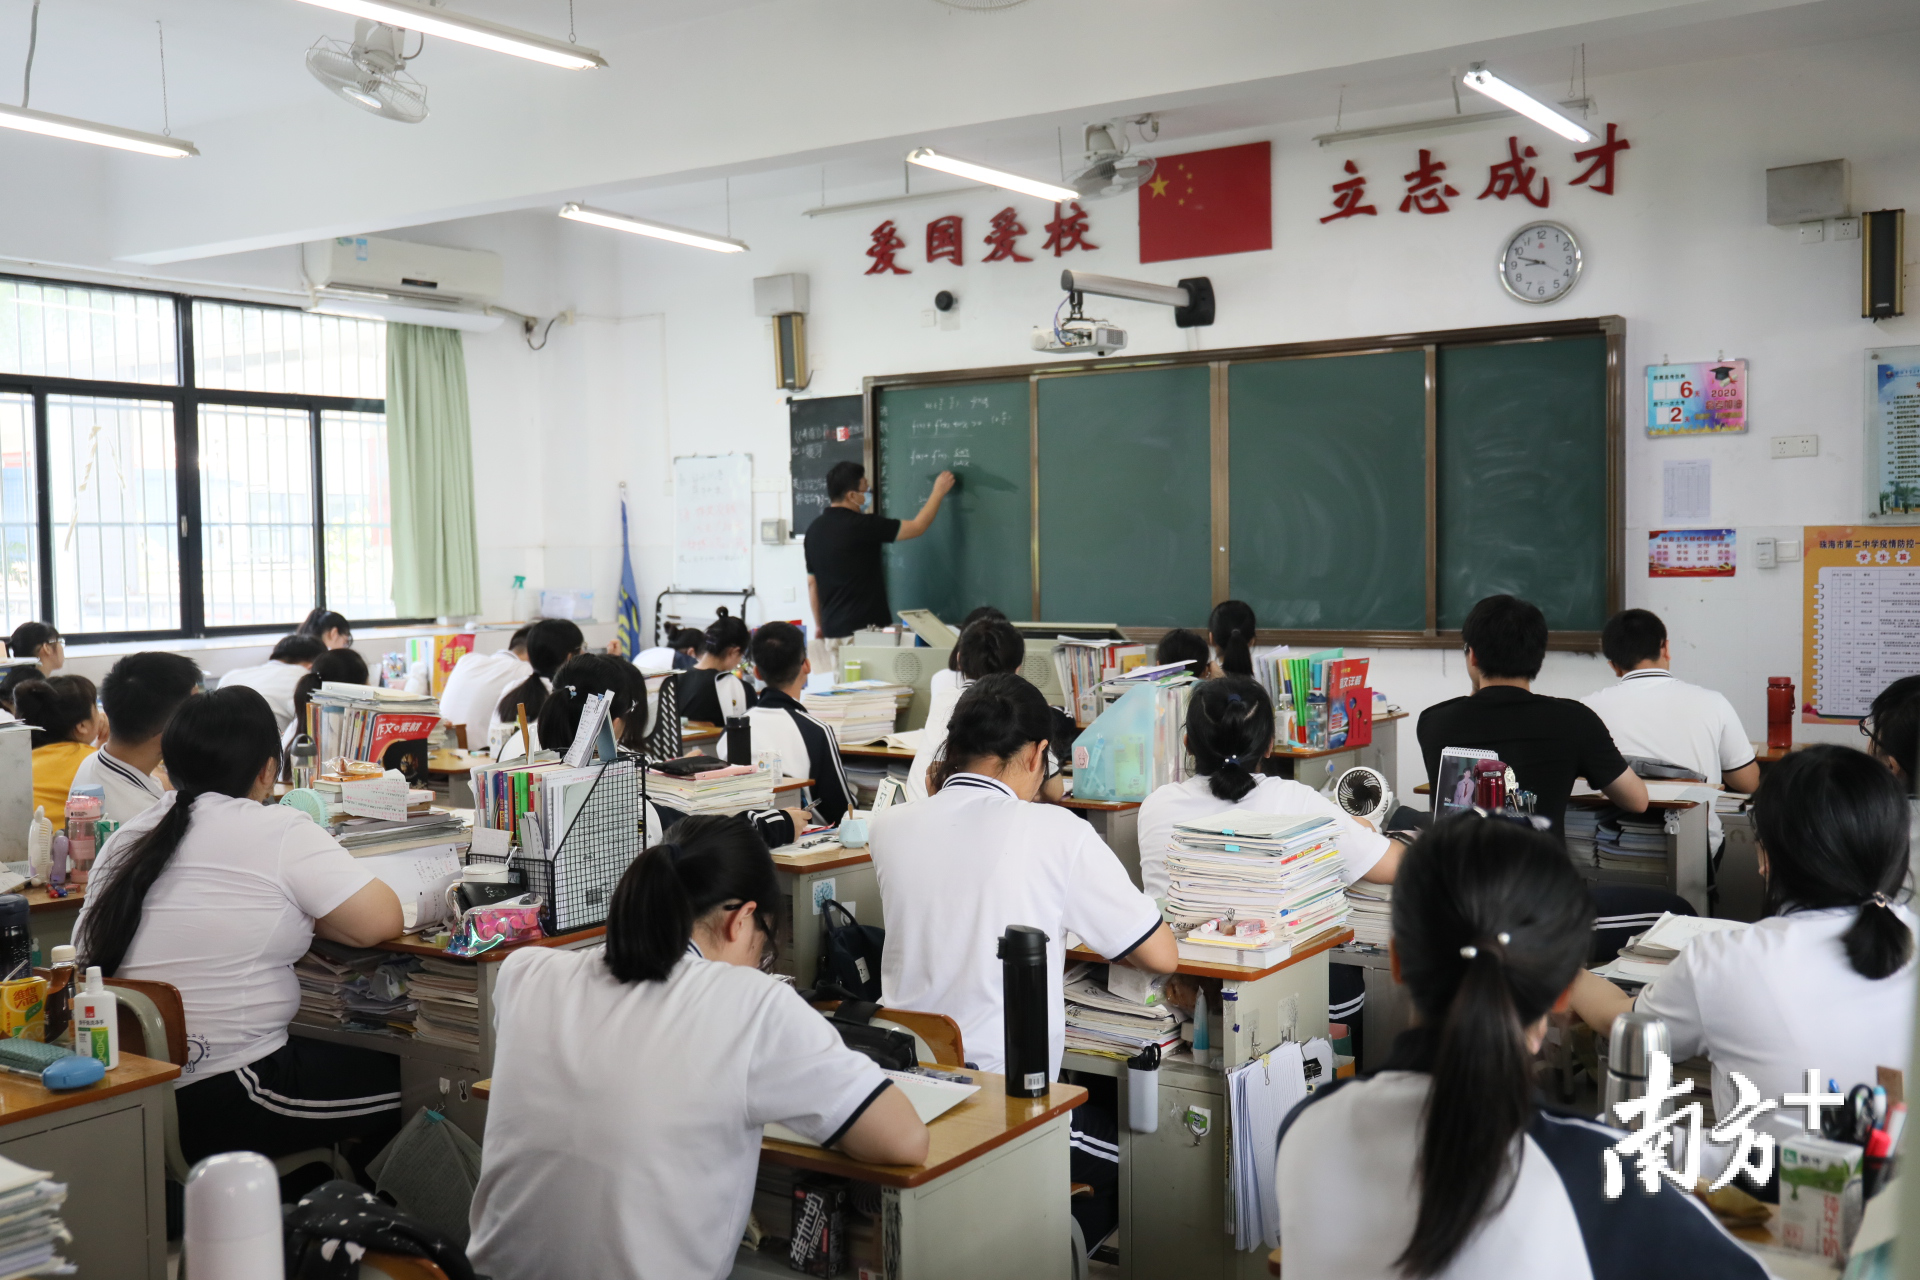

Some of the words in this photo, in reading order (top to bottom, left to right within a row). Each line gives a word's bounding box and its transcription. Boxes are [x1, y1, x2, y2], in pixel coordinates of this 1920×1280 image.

[1319, 122, 1631, 224] 立志成才
[864, 201, 1100, 275] 爱国爱校
[1536, 230, 1547, 240] 12
[1514, 246, 1524, 256] 10
[1563, 242, 1570, 252] 2
[1565, 255, 1573, 265] 3
[1511, 261, 1518, 270] 9
[1515, 273, 1522, 282] 8
[1563, 269, 1570, 278] 4
[1525, 281, 1532, 291] 7
[1553, 280, 1560, 289] 5
[1538, 286, 1545, 295] 6
[1680, 381, 1693, 398] 6
[1711, 389, 1737, 398] 2020
[1670, 407, 1682, 423] 2
